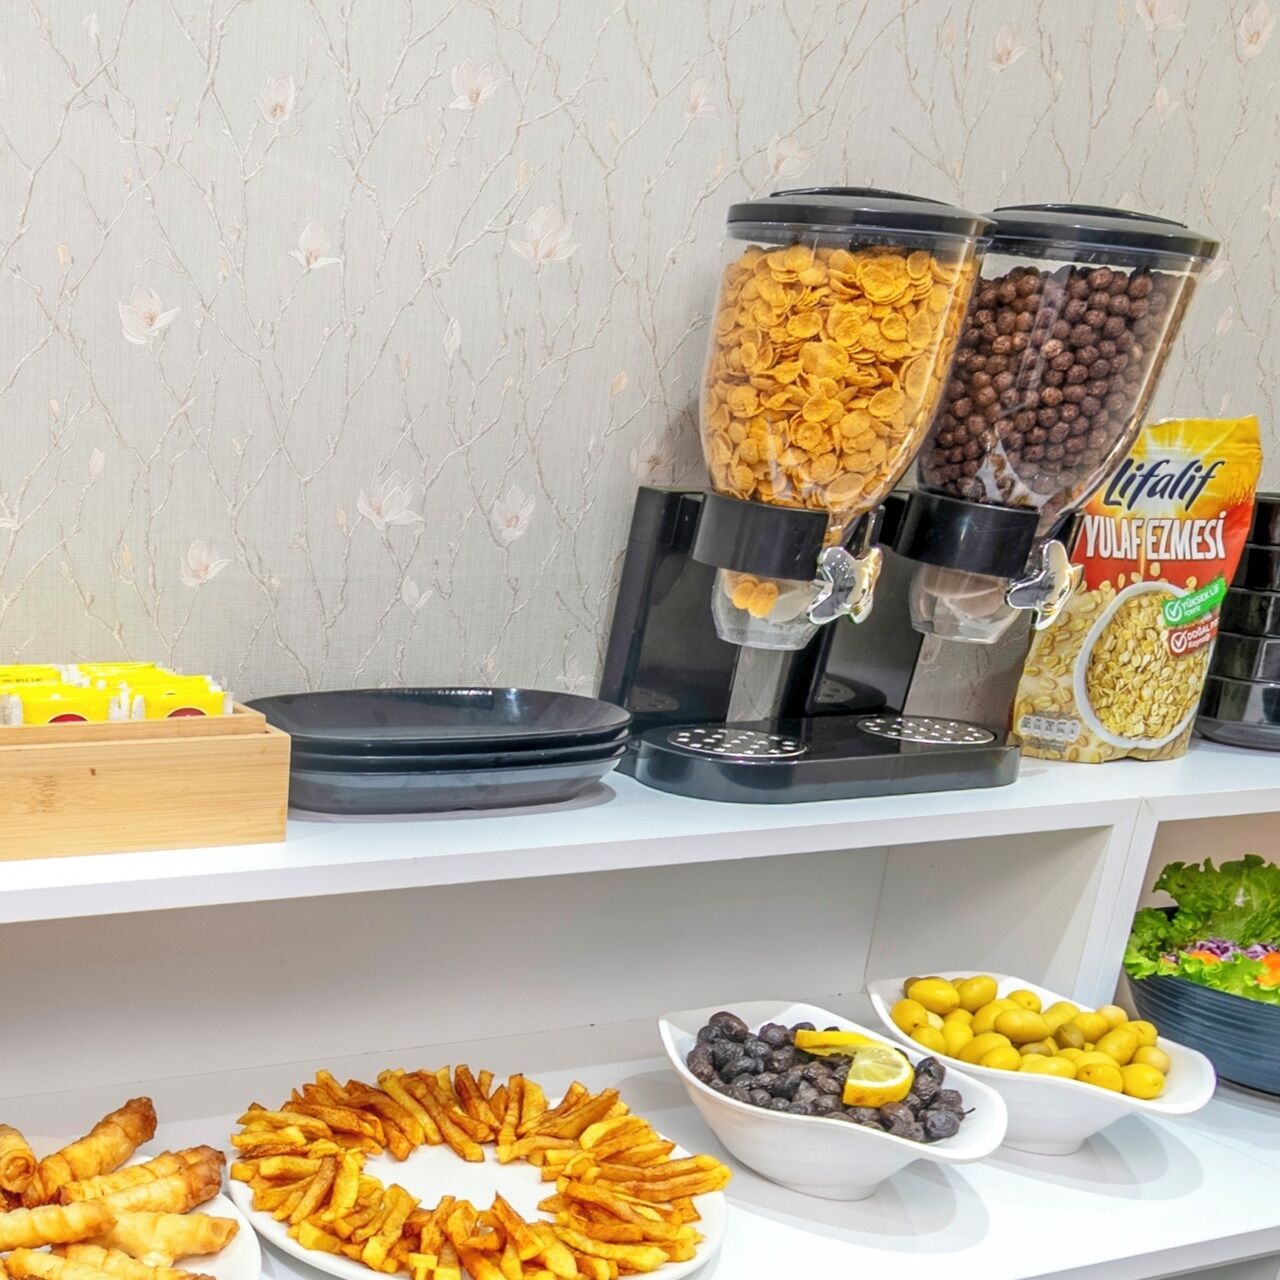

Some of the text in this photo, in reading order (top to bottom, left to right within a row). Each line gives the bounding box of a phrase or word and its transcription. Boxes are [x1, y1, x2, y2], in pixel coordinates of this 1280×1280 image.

[1103, 458, 1225, 512] Lifalif
[1084, 511, 1227, 561] YULAF EZMESİ
